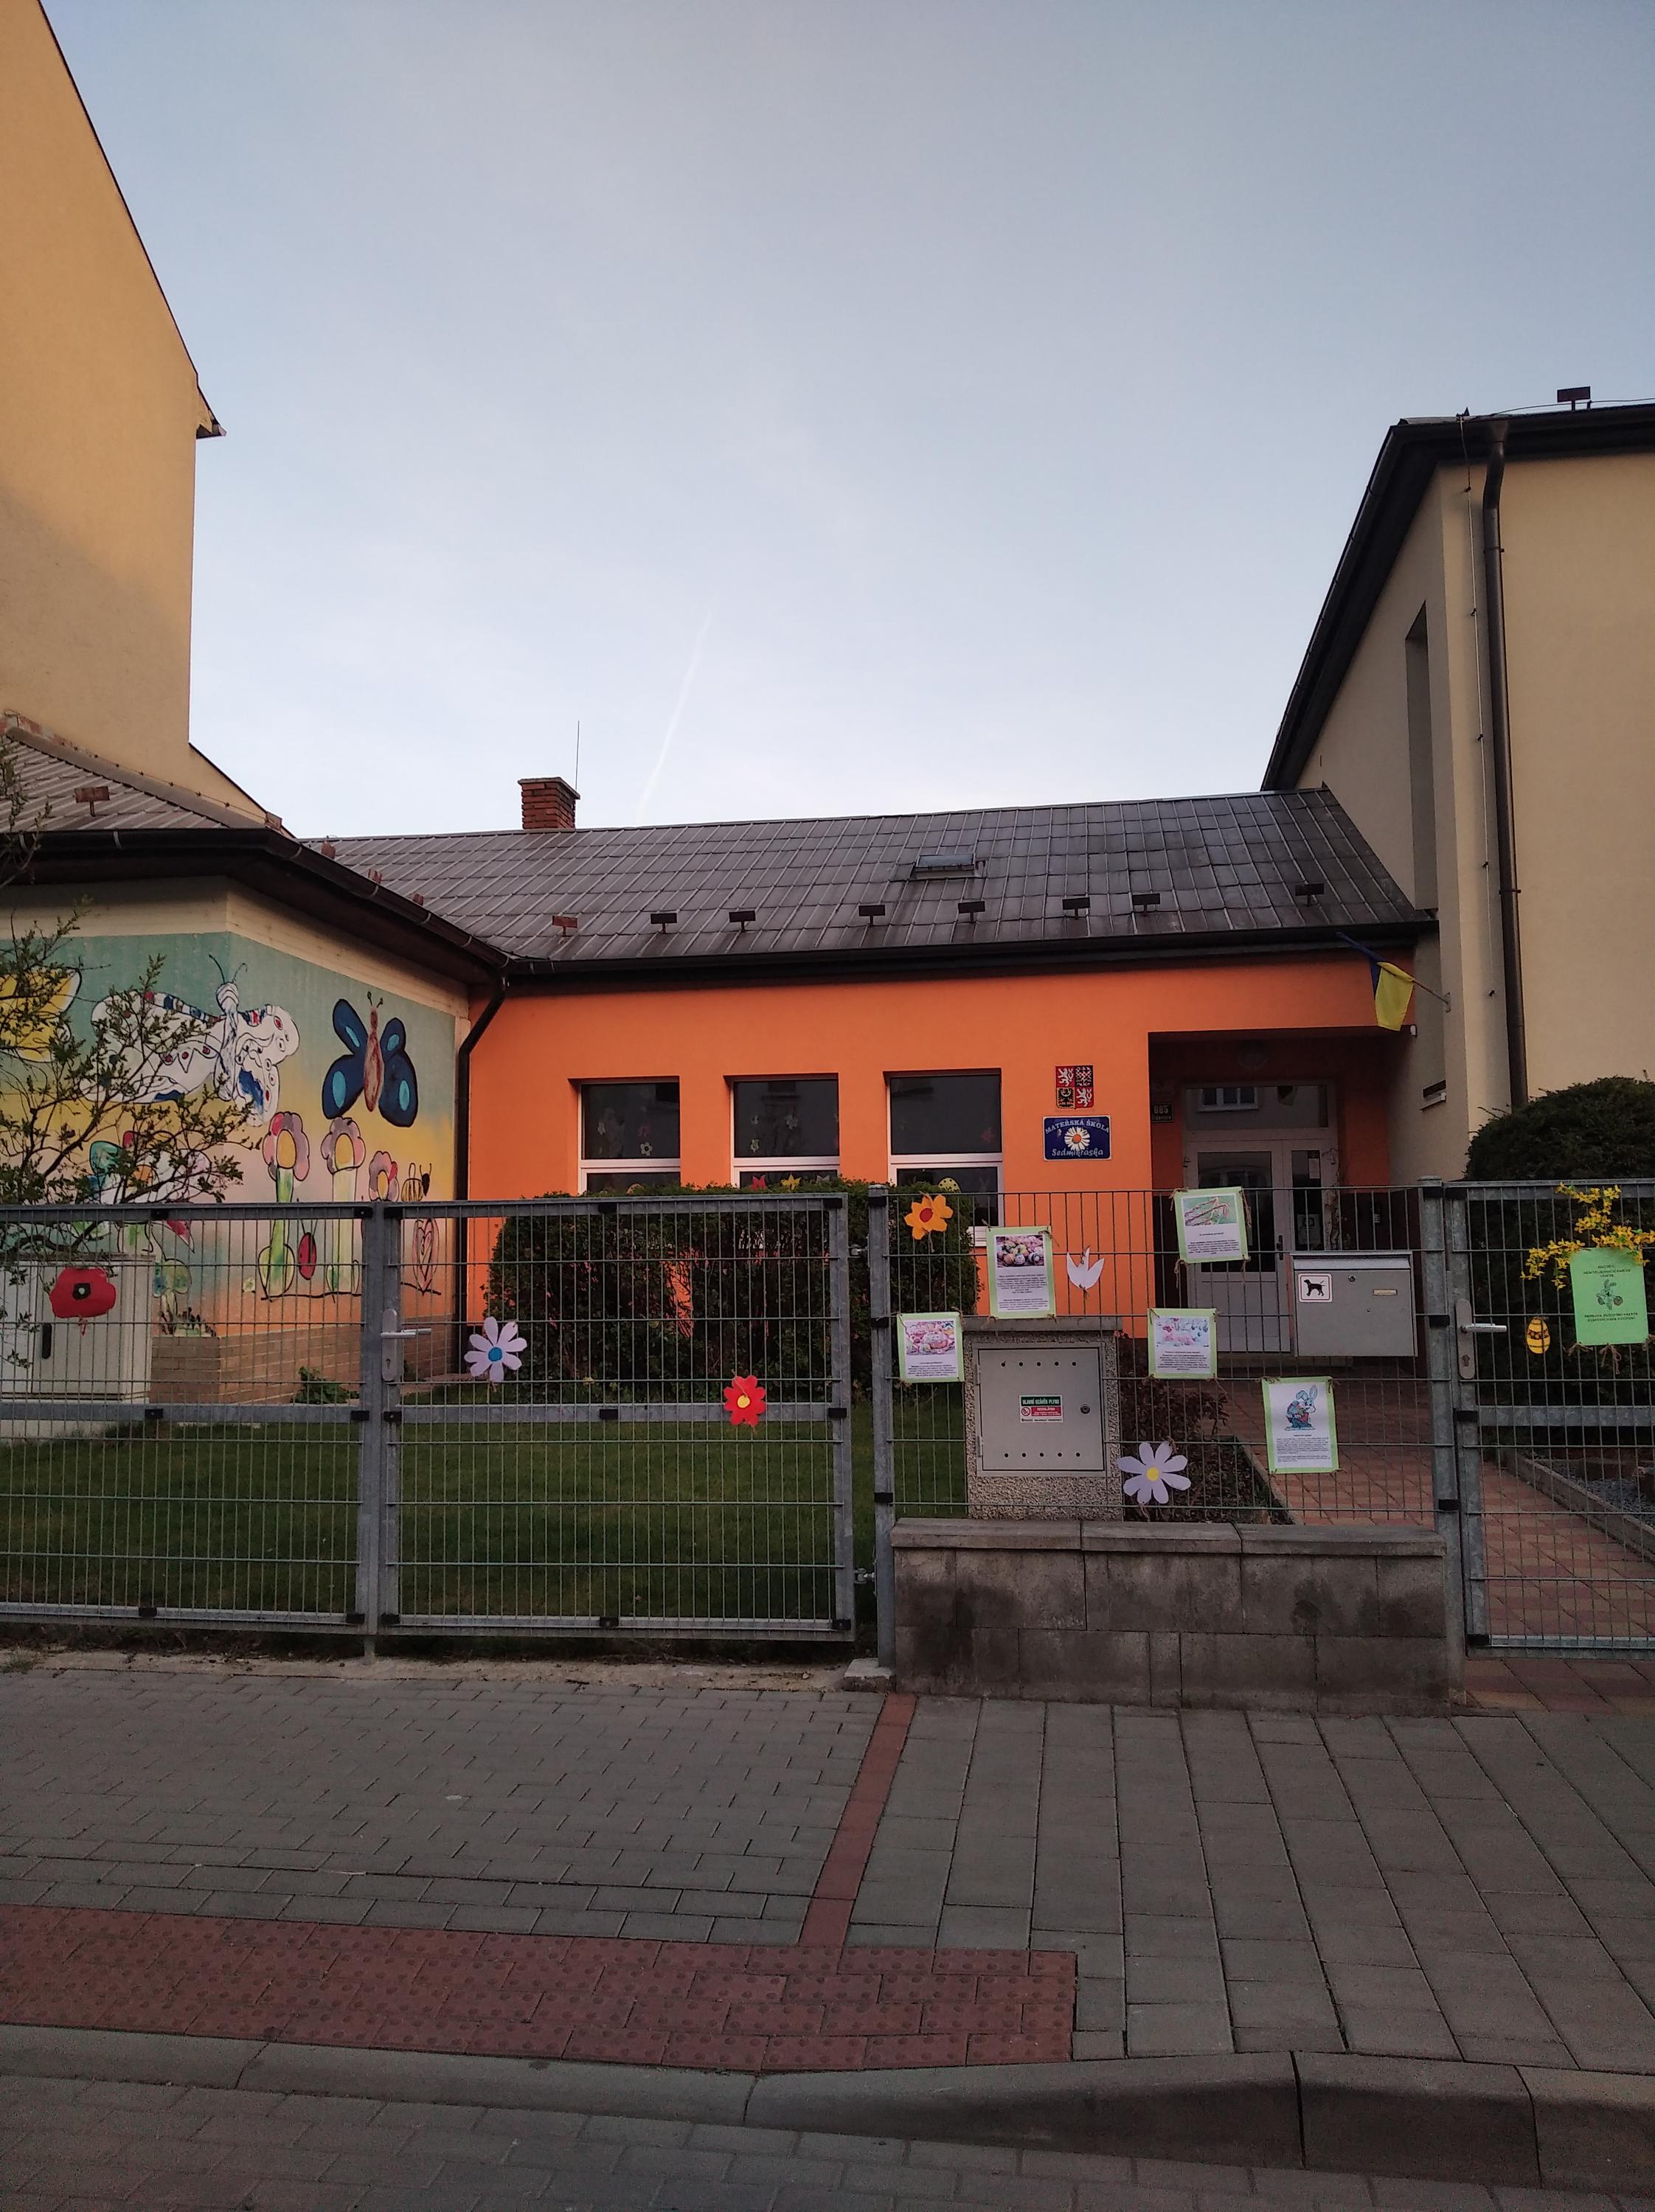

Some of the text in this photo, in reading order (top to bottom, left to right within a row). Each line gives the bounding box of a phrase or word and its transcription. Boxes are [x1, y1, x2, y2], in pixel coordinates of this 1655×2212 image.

[1153, 1105, 1169, 1114] 885
[1045, 1119, 1109, 1134] MATEŘSKÁ ŠKOLA
[1052, 1147, 1103, 1158] Sedmikráska
